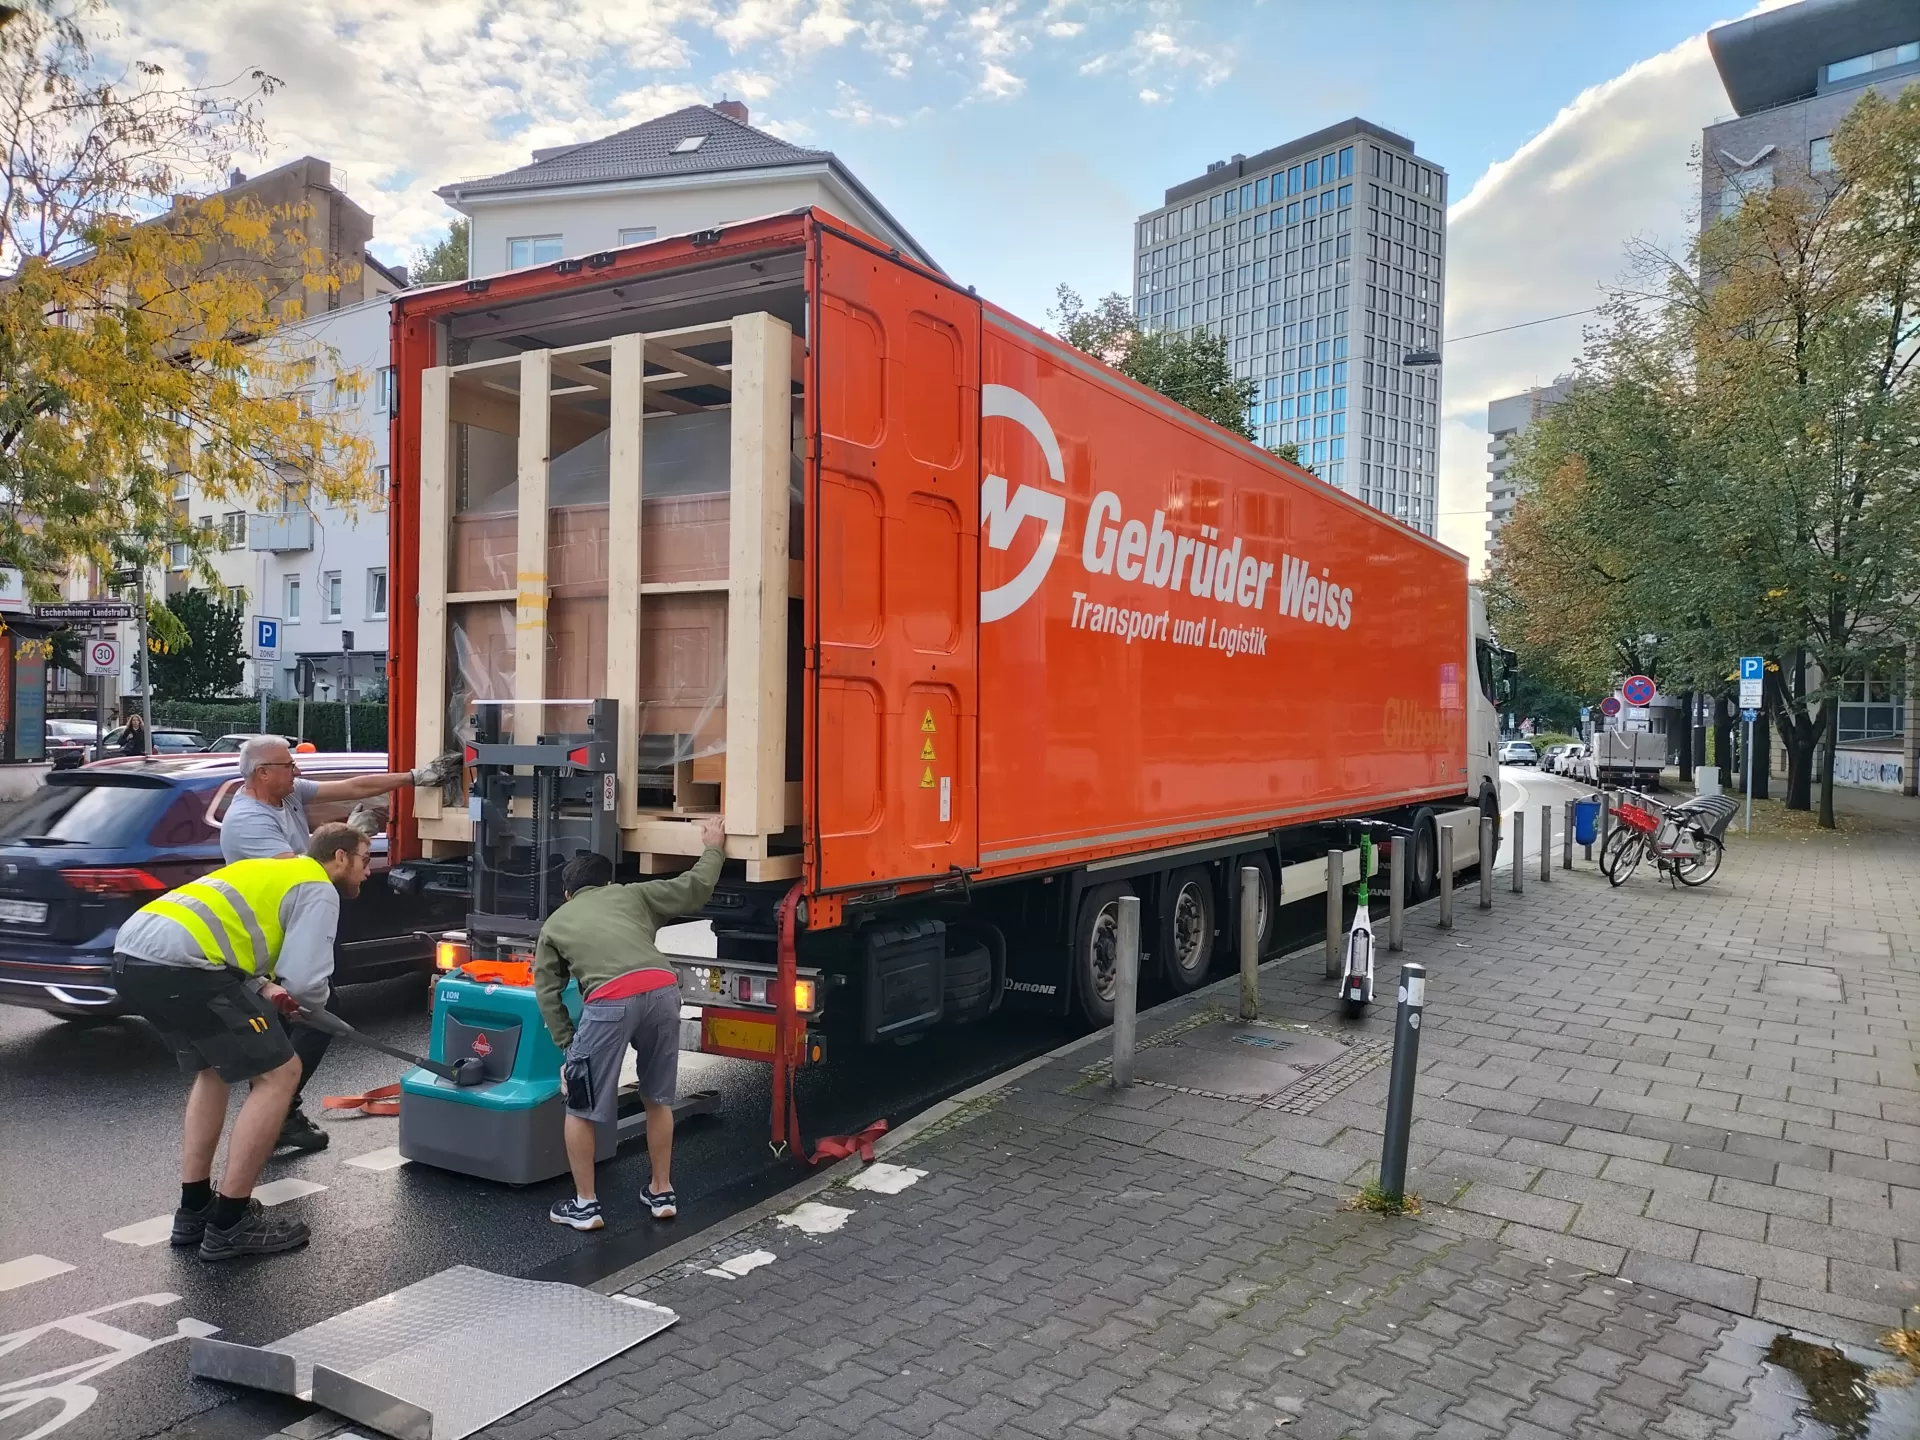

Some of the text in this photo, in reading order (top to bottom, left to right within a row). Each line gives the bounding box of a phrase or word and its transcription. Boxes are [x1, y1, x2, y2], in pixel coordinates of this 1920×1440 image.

[1082, 490, 1353, 631] Gebrüder Weiss
[40, 607, 128, 617] Eschersheimer Landstraße
[1070, 591, 1267, 658] Transport und Logistik
[262, 624, 273, 644] P
[96, 648, 111, 660] 30
[259, 649, 275, 658] ZONE
[94, 666, 112, 674] ZONE
[1745, 660, 1759, 678] P
[1013, 981, 1057, 995] KRONE
[440, 990, 460, 1002] LION
